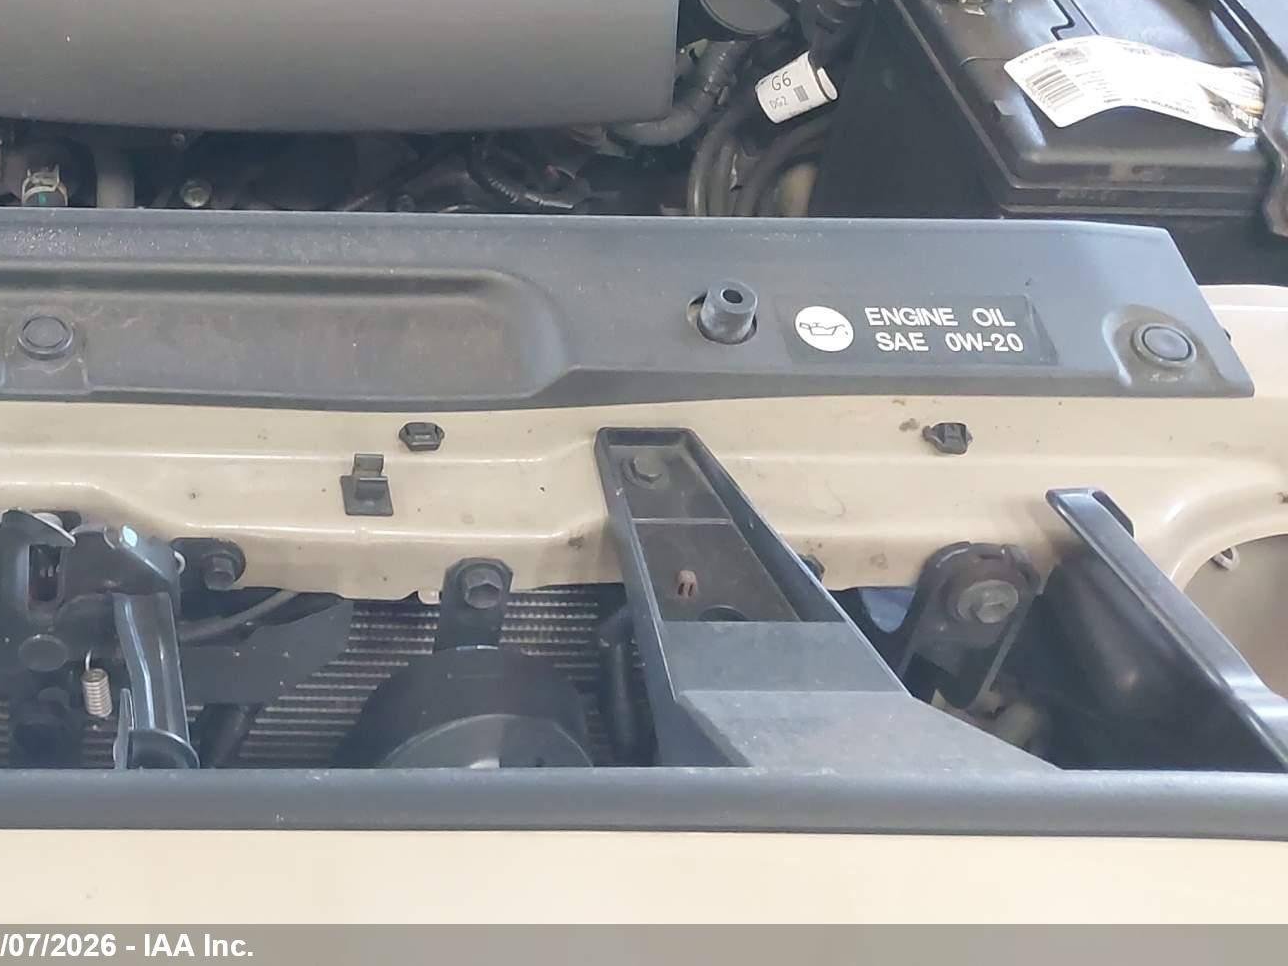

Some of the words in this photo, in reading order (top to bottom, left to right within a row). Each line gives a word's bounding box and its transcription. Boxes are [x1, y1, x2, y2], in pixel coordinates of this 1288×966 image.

[771, 71, 792, 91] G6
[864, 307, 959, 327] ENGINE
[972, 307, 1016, 327] OIL
[875, 332, 929, 352] SAE
[944, 332, 1024, 352] 0W-20
